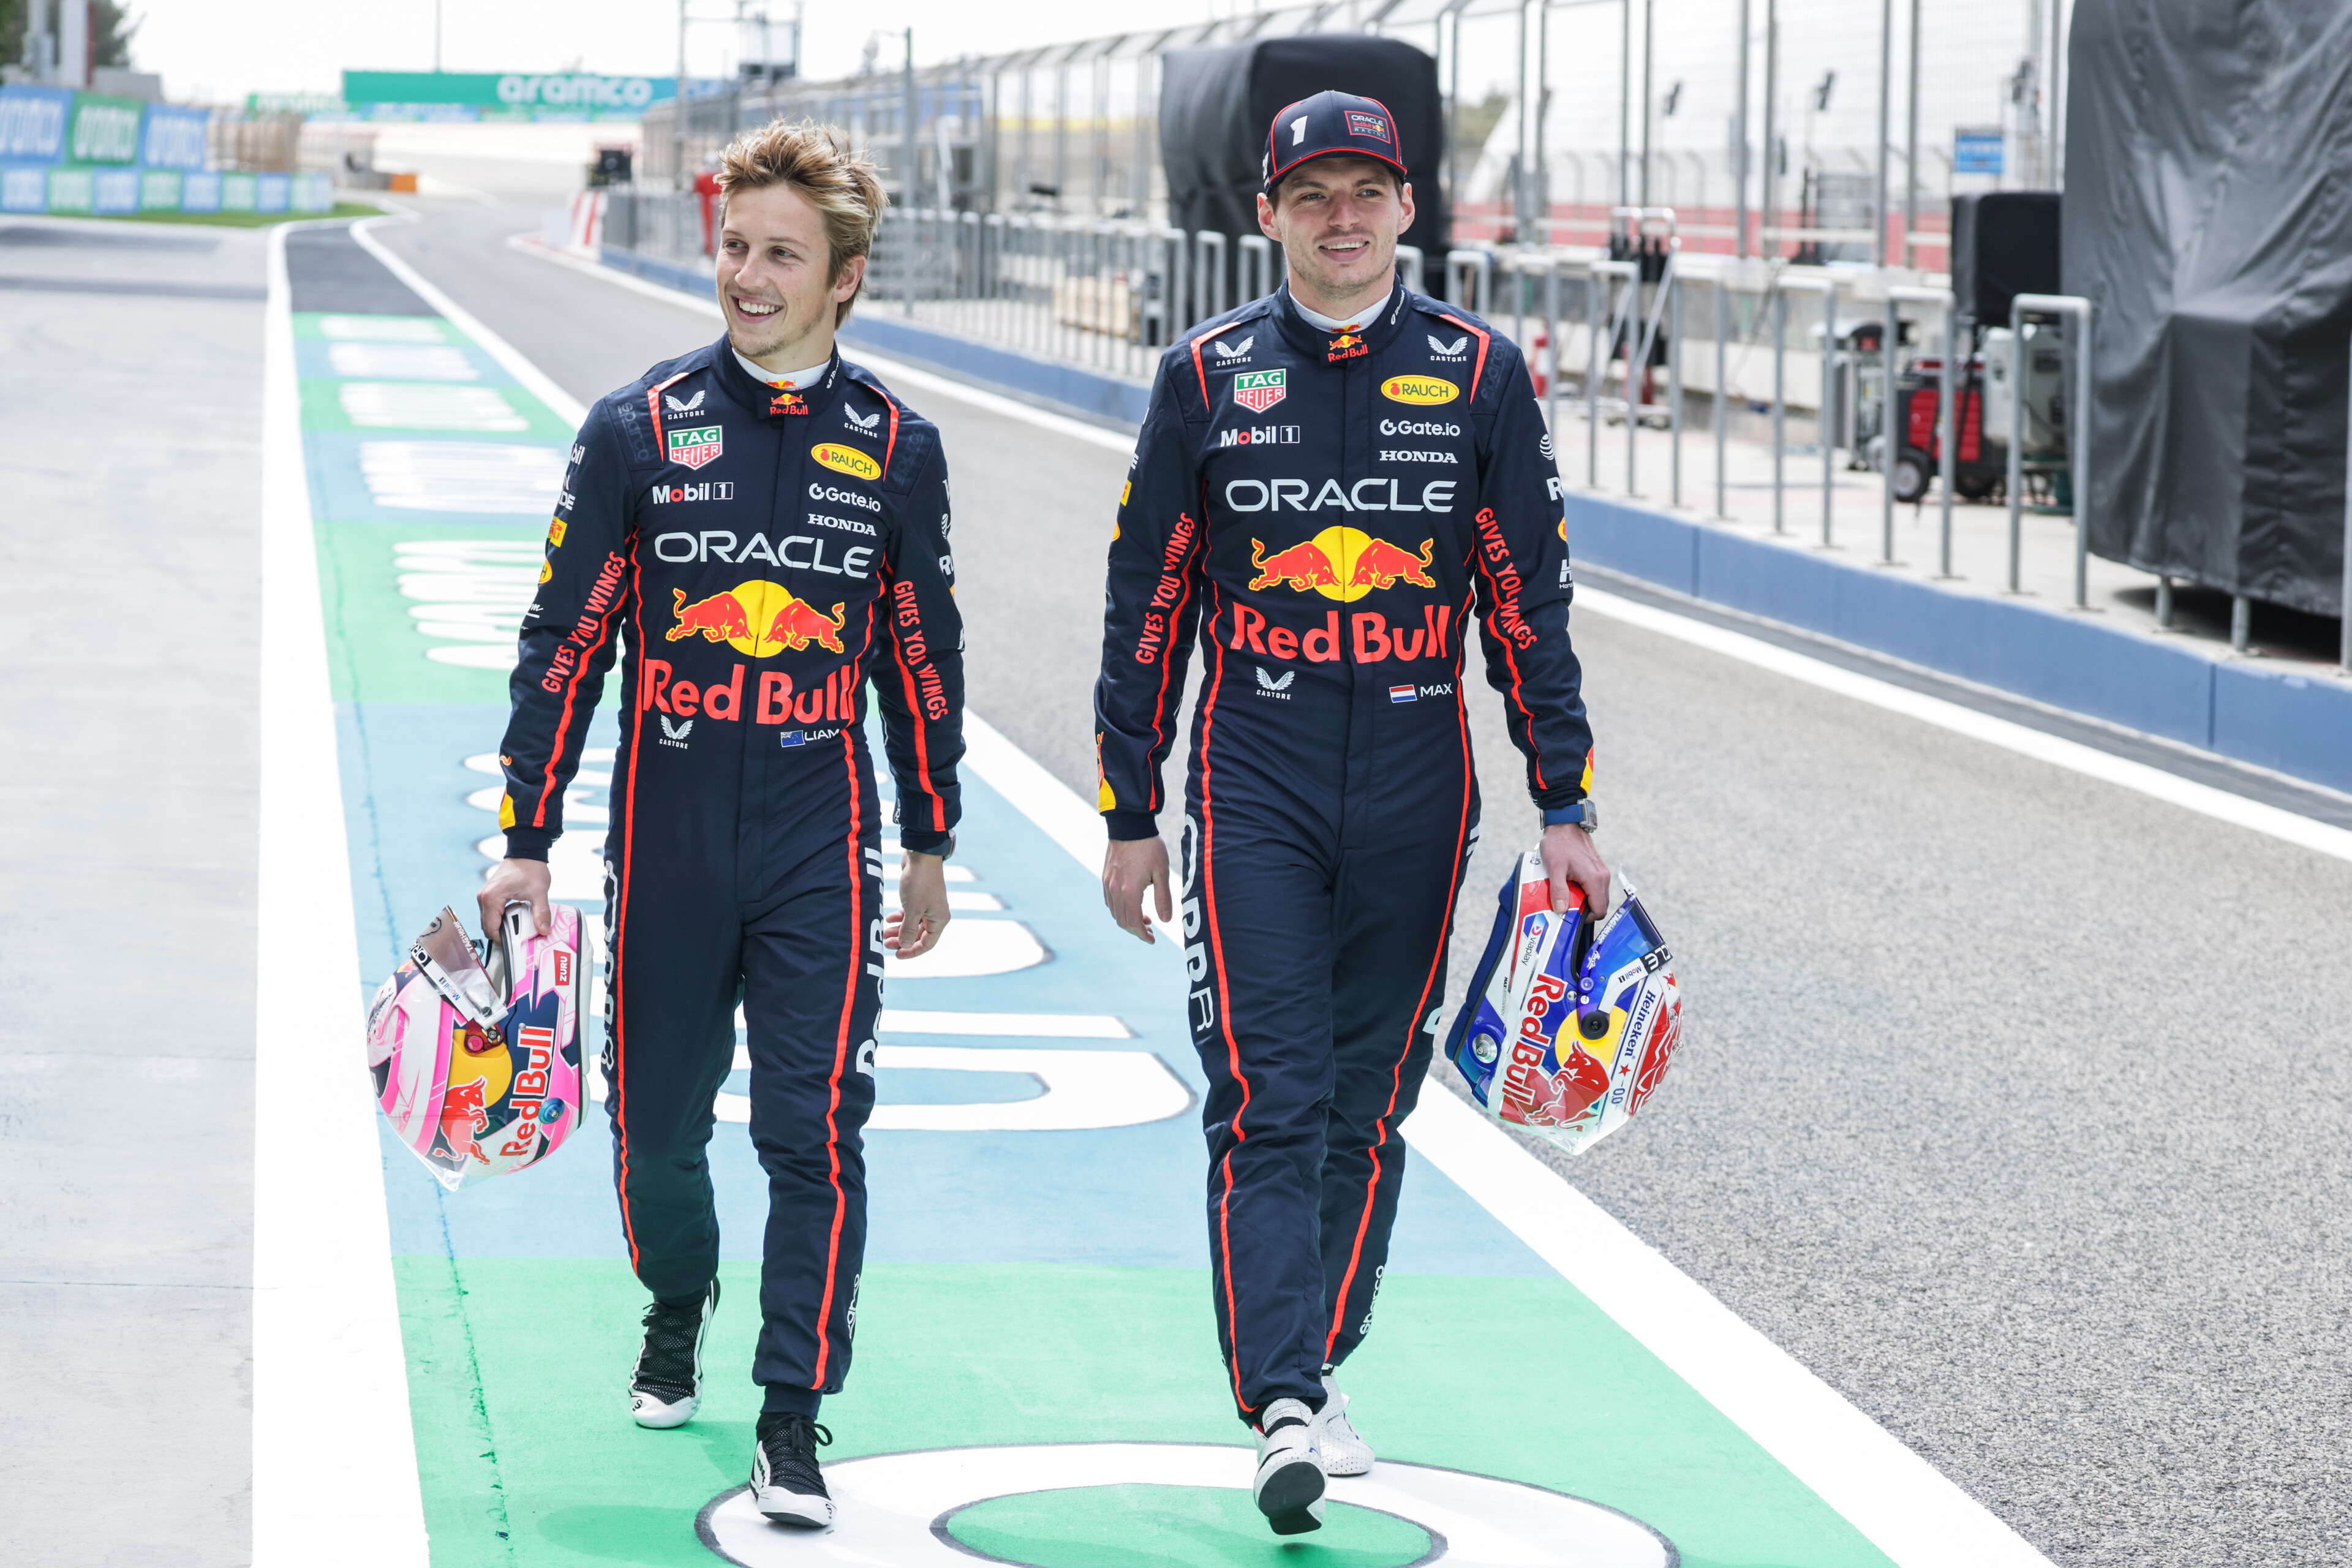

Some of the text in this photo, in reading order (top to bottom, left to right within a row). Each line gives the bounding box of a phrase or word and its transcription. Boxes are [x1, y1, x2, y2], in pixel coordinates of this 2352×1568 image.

[496, 75, 653, 107] aramco
[1290, 115, 1308, 147] 1
[1351, 115, 1384, 127] ORACLE
[1354, 127, 1386, 139] RACING
[1216, 356, 1251, 367] CASTORE
[1328, 344, 1368, 363] Red Bull
[1239, 372, 1281, 388] TAG
[1402, 383, 1449, 398] RAUCH
[1237, 388, 1283, 409] HEUER
[668, 410, 705, 420] CASTORE
[769, 404, 809, 415] Red Bull
[673, 429, 717, 445] TAG
[844, 422, 878, 438] CASTORE
[1220, 426, 1276, 447] Mobil
[1398, 420, 1461, 437] Gate.io
[673, 445, 719, 466] HEUER
[831, 451, 873, 475] RAUCH
[1379, 450, 1458, 464] HONDA
[652, 483, 710, 504] Mobil
[826, 487, 881, 512] Gate.io
[1226, 478, 1457, 512] ORACLE
[808, 513, 876, 537] HONDA
[1475, 507, 1510, 562] GIVES
[654, 530, 875, 579] ORACLE
[1135, 512, 1196, 665] GIVES YOU WINGS
[541, 551, 626, 693] GIVES YOU WINGS
[1229, 601, 1451, 663] Red Bull
[893, 580, 921, 627] GIVES
[916, 662, 948, 721] WINGS
[643, 658, 851, 725] Red Bull
[1256, 689, 1291, 700] CASTORE
[1420, 683, 1453, 697] MAX
[659, 739, 688, 750] CASTORE
[804, 729, 840, 741] LIAM
[1521, 937, 1537, 966] viaplay
[559, 956, 568, 981] ZURU
[1625, 965, 1642, 980] Mobil
[443, 983, 461, 1001] Mobil
[1624, 989, 1656, 1057] Heineken
[1502, 974, 1566, 1104] Red Bull
[499, 1028, 552, 1156] Red Bull
